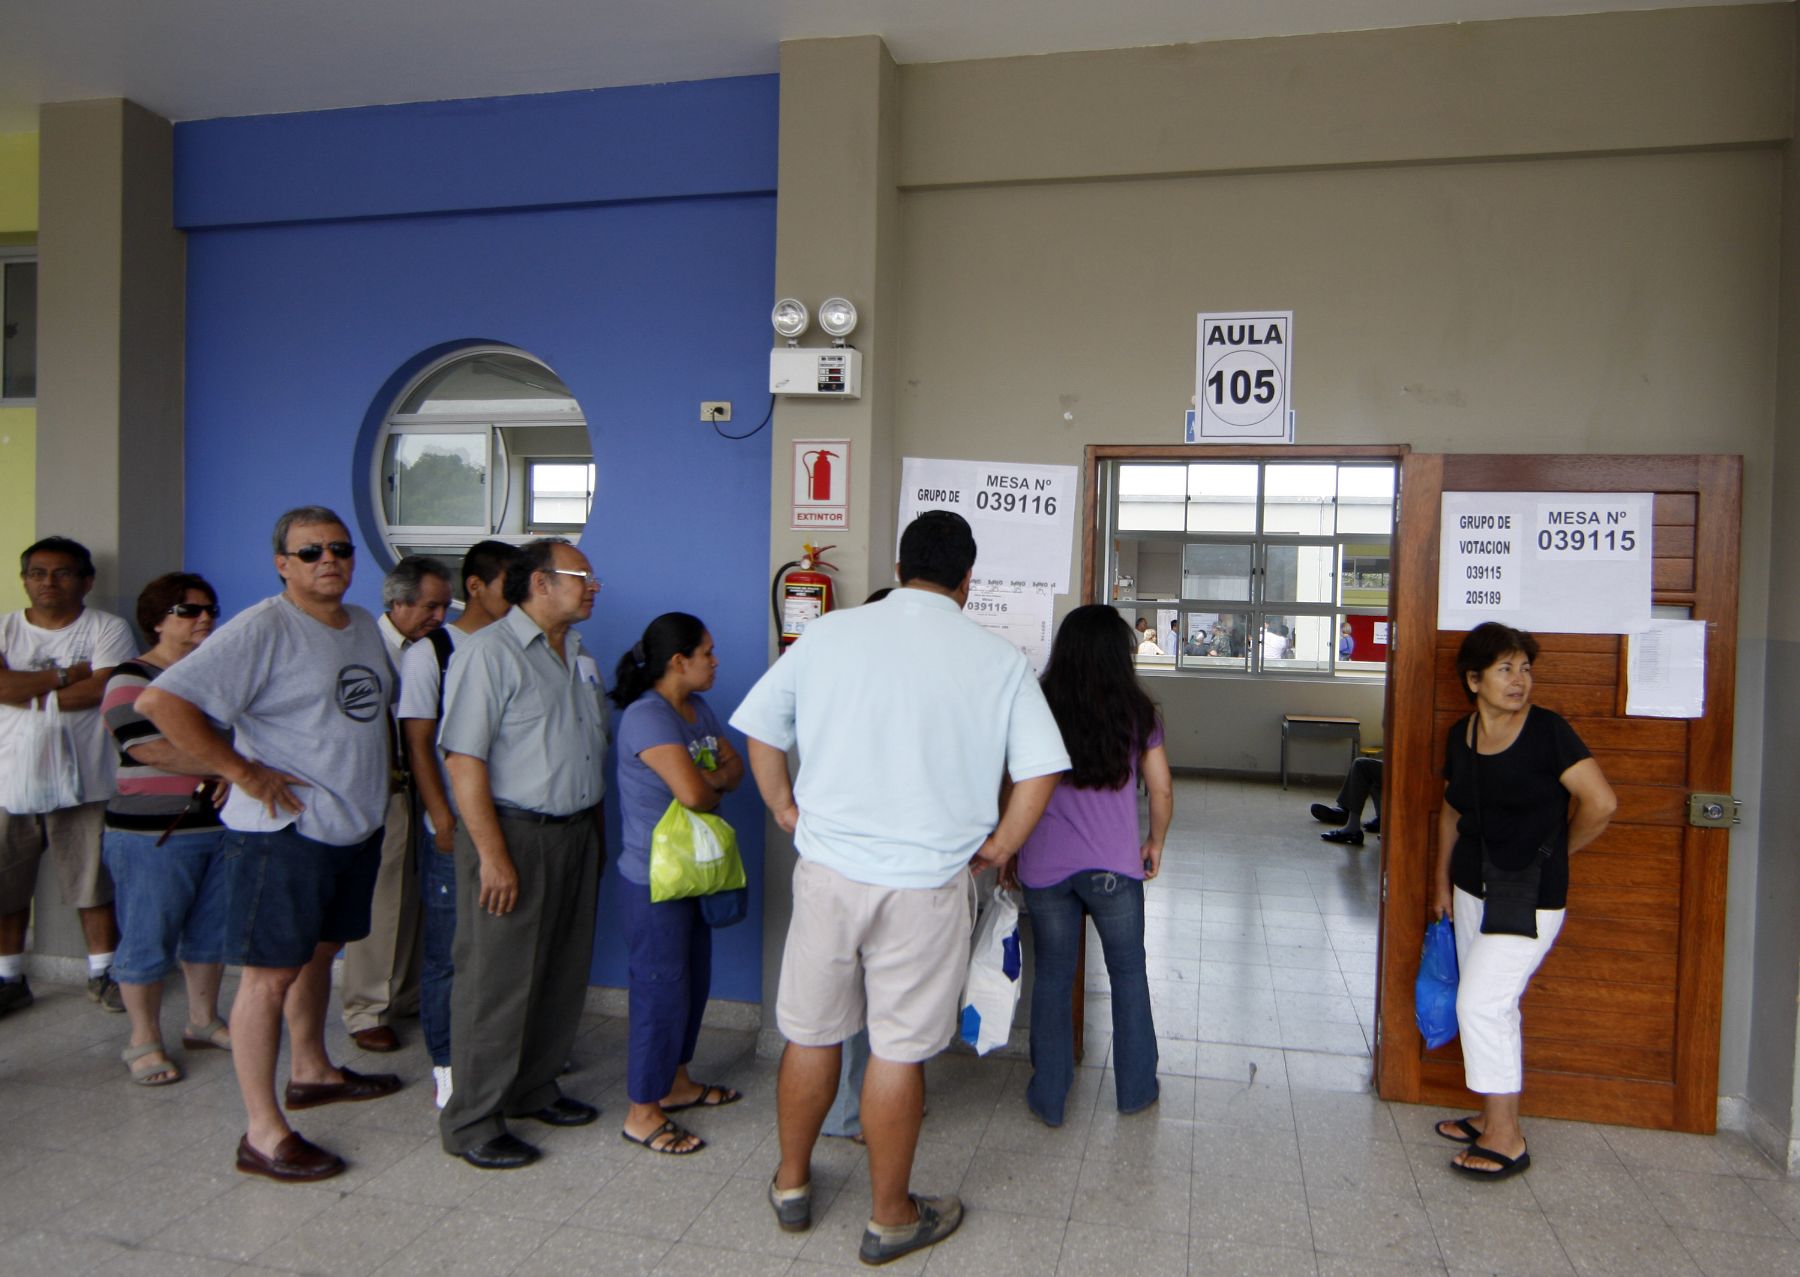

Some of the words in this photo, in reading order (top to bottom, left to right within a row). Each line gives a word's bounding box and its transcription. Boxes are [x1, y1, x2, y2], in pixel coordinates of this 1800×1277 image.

[1207, 324, 1282, 345] AULA
[1208, 370, 1275, 404] 105
[986, 475, 1029, 489] MESA
[917, 489, 946, 502] GRUPO
[949, 490, 960, 503] DE
[976, 491, 1057, 515] 039116
[797, 513, 843, 521] EXTINTOR
[1460, 515, 1495, 529] GRUPO
[1497, 516, 1511, 529] DE
[1548, 511, 1600, 525] MESA
[1538, 529, 1635, 551] 039115
[1459, 541, 1510, 554] VOTACION
[1466, 566, 1501, 579] 039115
[1466, 591, 1501, 604] 205189
[967, 601, 1008, 612] 039116
